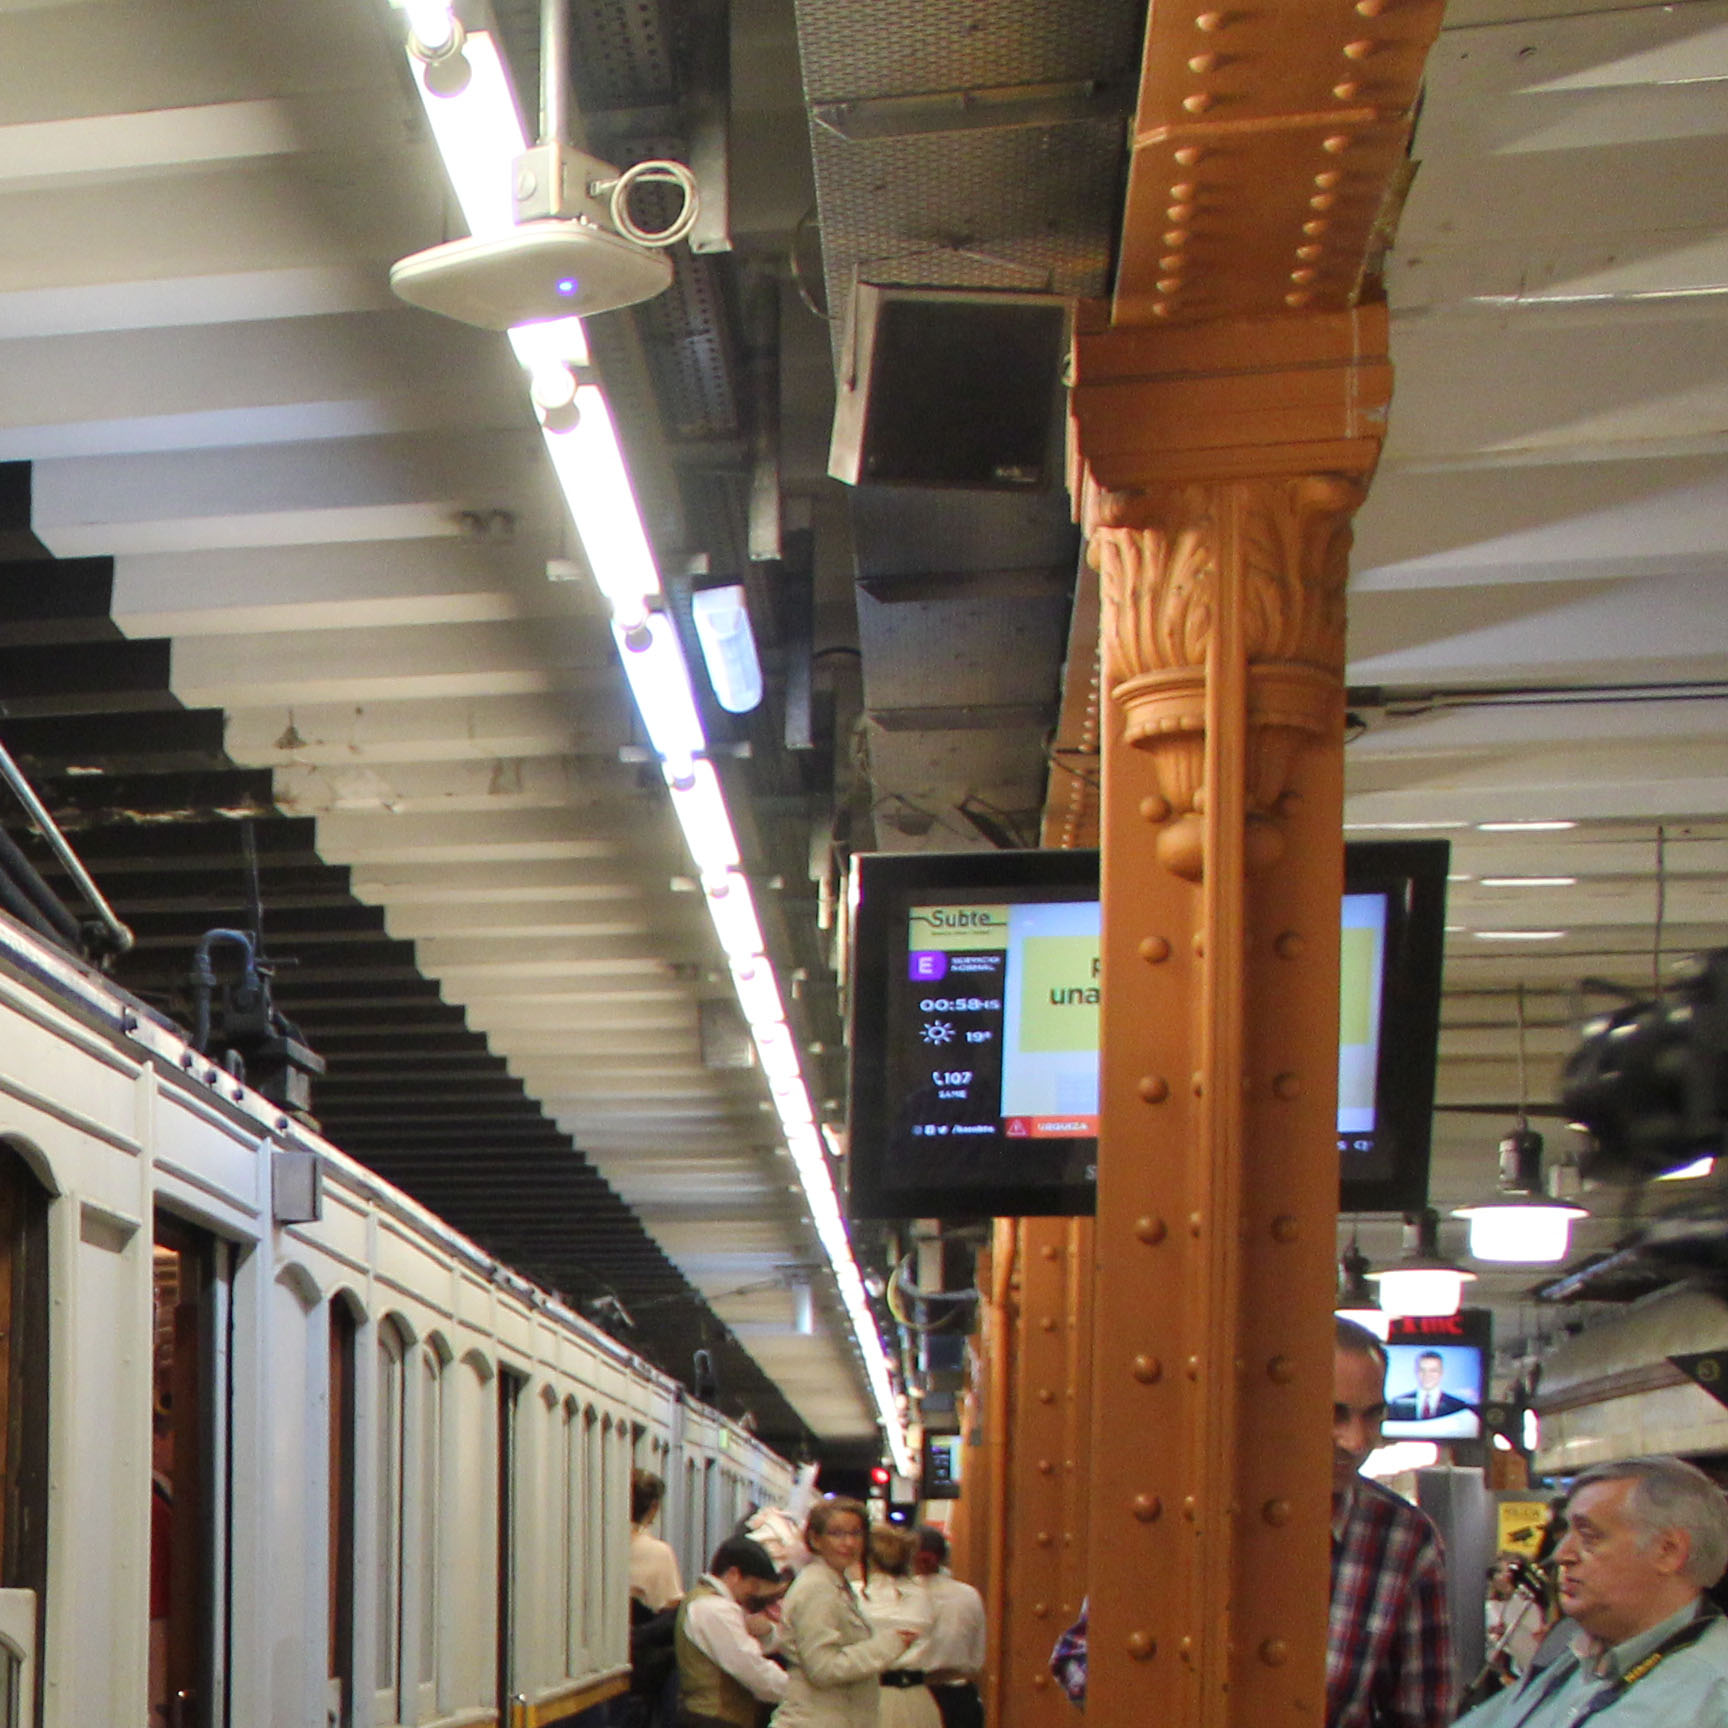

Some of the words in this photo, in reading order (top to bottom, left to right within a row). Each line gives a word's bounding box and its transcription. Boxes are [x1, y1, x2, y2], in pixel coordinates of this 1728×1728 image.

[930, 910, 992, 928] Subte
[918, 956, 934, 975] E
[944, 1071, 973, 1085] 107
